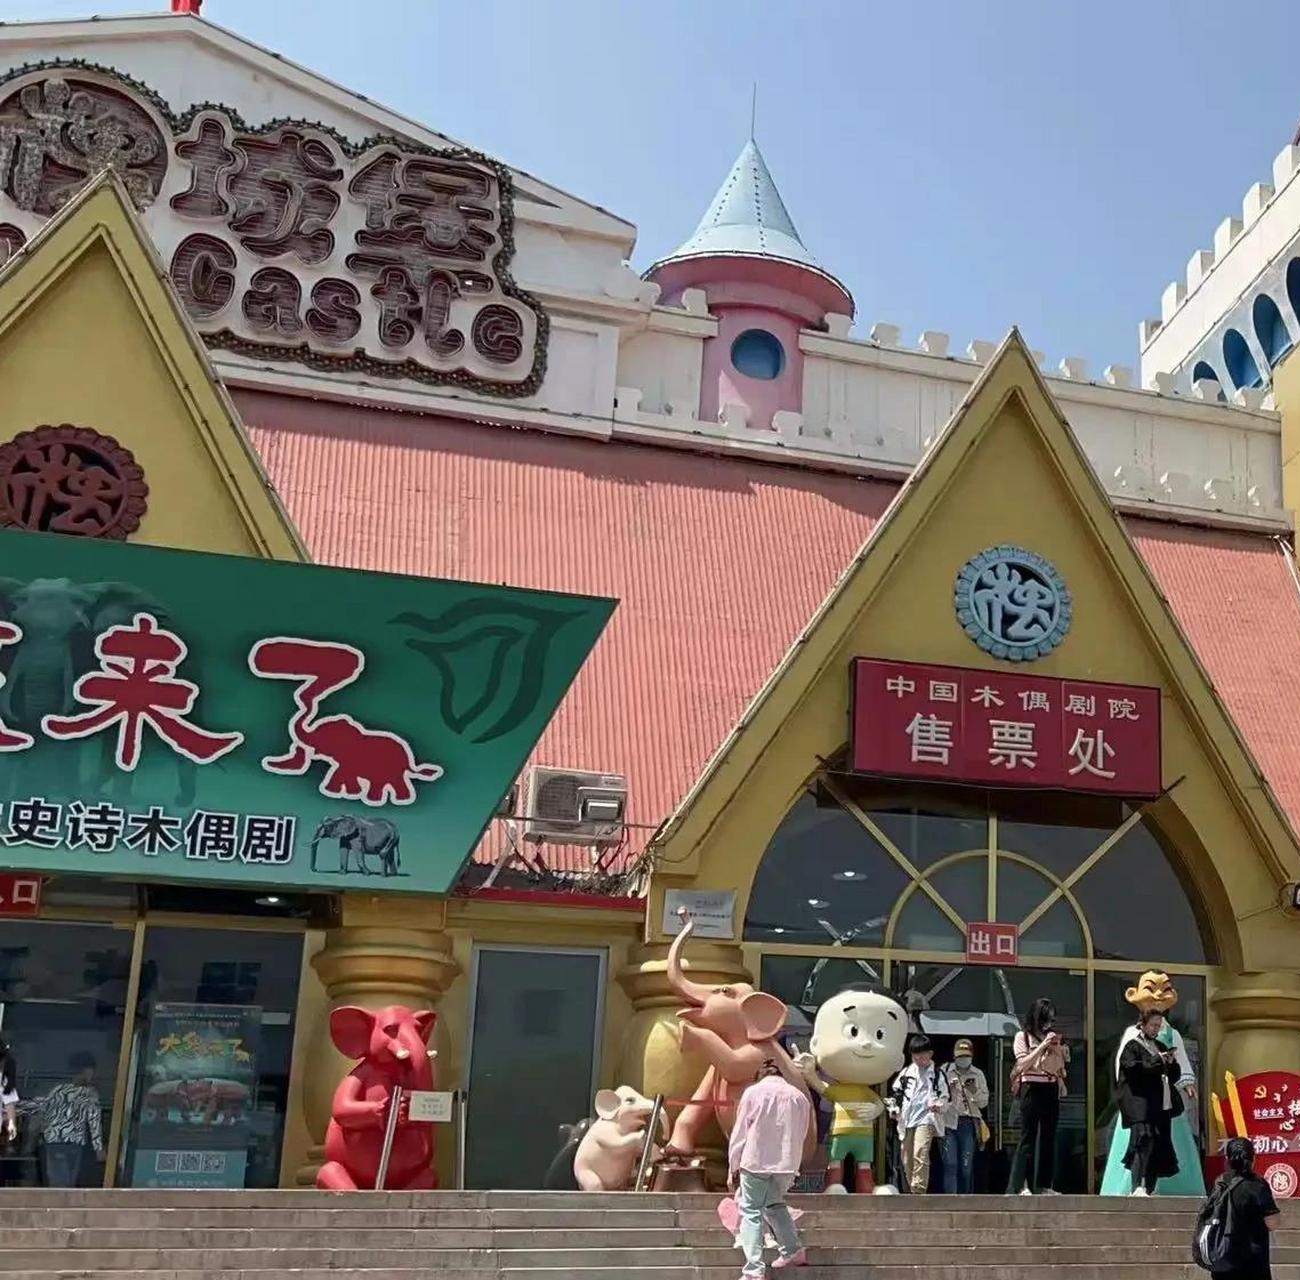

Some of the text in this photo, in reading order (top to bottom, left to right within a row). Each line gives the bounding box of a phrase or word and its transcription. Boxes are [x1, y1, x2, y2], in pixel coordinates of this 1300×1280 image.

[170, 118, 497, 294] 城堡
[171, 233, 524, 366] Castle
[0, 612, 443, 805] 来了
[886, 674, 1141, 722] 中国木偶剧院
[905, 711, 1117, 780] 售票处
[970, 930, 1016, 957] 出口
[1253, 1107, 1285, 1118] 社会主义
